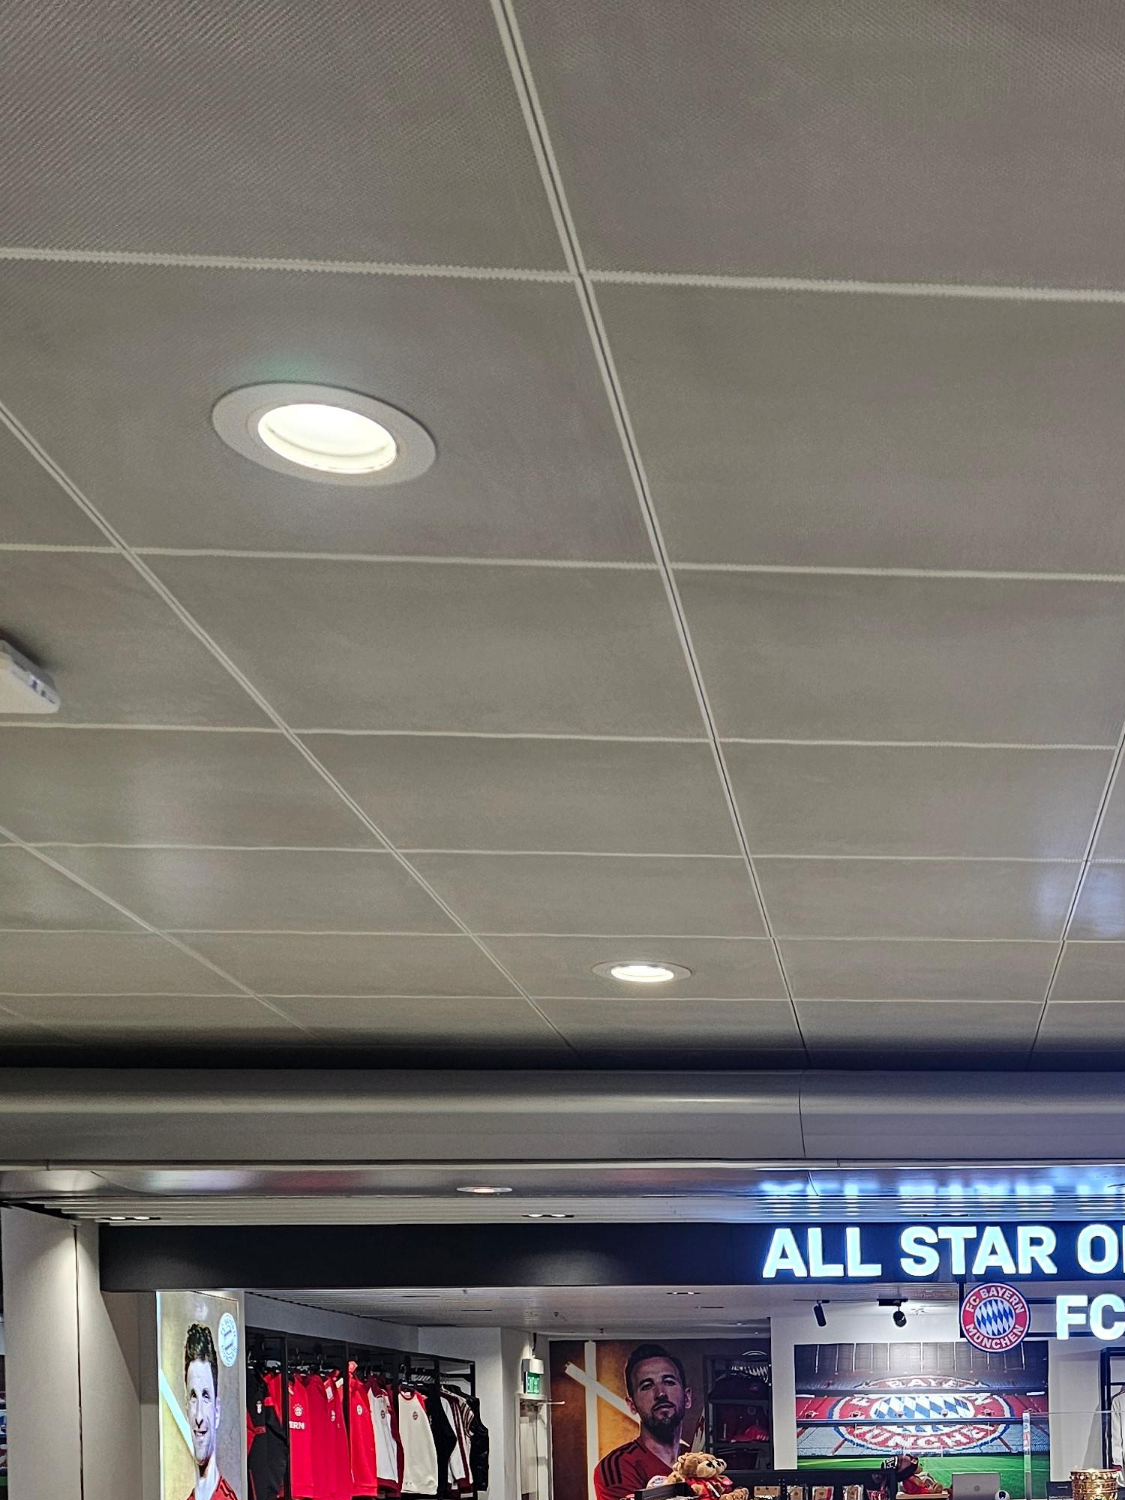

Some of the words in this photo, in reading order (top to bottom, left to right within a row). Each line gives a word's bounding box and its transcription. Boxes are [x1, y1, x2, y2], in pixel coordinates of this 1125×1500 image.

[762, 1227, 882, 1278] ALL
[900, 1225, 1058, 1277] STAR
[965, 1296, 980, 1312] FC
[980, 1287, 1024, 1313] BAYERN
